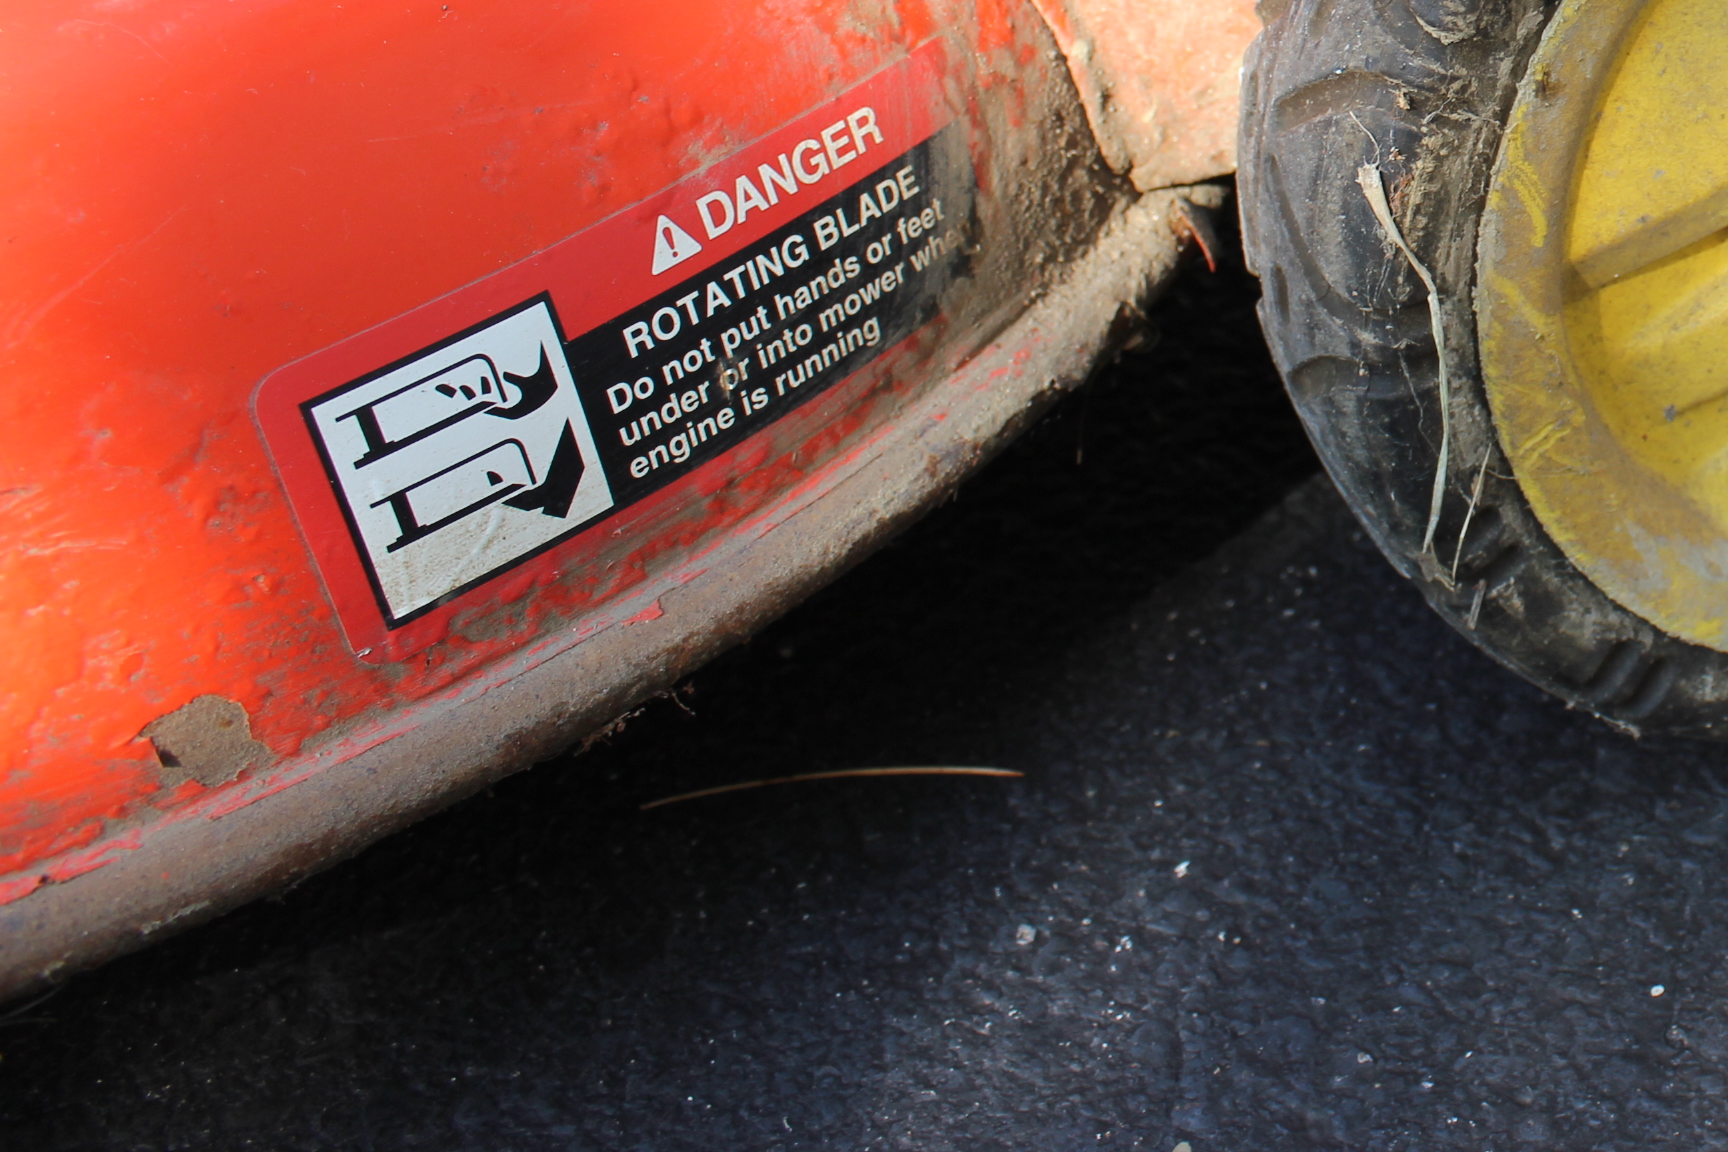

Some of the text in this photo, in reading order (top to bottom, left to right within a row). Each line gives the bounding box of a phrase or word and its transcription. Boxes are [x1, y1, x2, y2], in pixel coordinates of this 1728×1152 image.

[621, 165, 921, 359] ROTATING BLADE
[696, 106, 885, 240] DANGER
[605, 197, 945, 415] Do not put hands or feet
[618, 381, 711, 447] under
[720, 359, 750, 392] or
[757, 323, 813, 370] into
[819, 261, 905, 332] mower
[629, 316, 881, 479] engine is running
